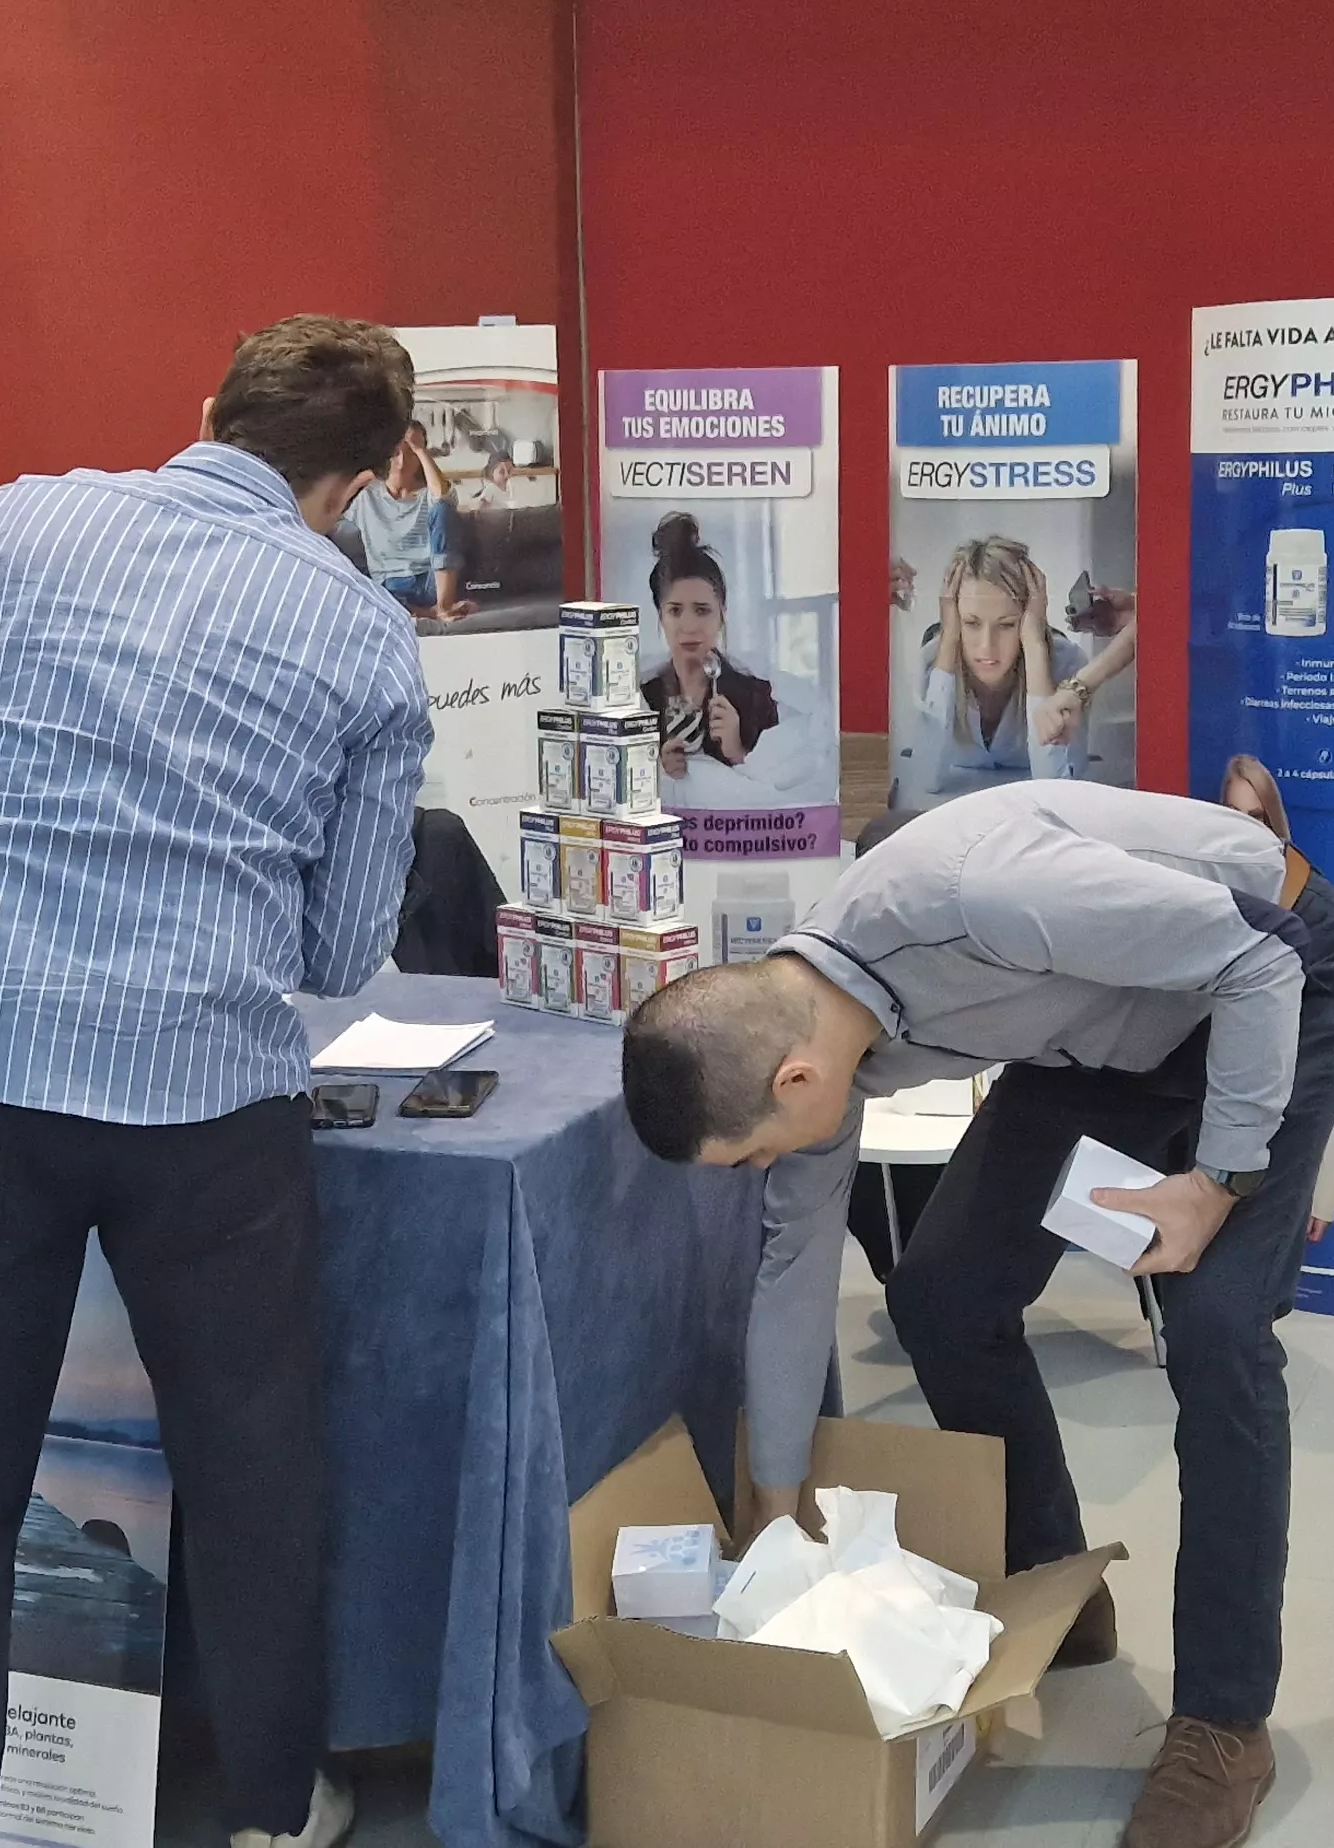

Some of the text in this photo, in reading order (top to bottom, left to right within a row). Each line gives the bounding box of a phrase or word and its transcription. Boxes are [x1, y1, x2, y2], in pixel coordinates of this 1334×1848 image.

[1204, 330, 1224, 355] ¿LE
[1224, 328, 1263, 349] FALTA
[1267, 325, 1318, 346] VIDA
[644, 388, 755, 413] EQUILIBRA
[938, 384, 1051, 409] RECUPERA
[940, 409, 1047, 438] TU ÁNIMO
[1222, 407, 1280, 421] RESTAURA
[1284, 406, 1304, 419] TU
[622, 414, 786, 439] TUS EMOCIONES
[620, 460, 791, 487] VECTISEREN
[907, 459, 1096, 488] ERGYSTRESS
[1219, 460, 1313, 479] ERGYPHILUS
[1281, 480, 1312, 497] Plus
[500, 671, 542, 701] más
[1282, 685, 1328, 696] Terrenos
[703, 811, 806, 835] deprimido?
[704, 833, 818, 856] compulsivo?
[7, 1743, 66, 1763] minerales
